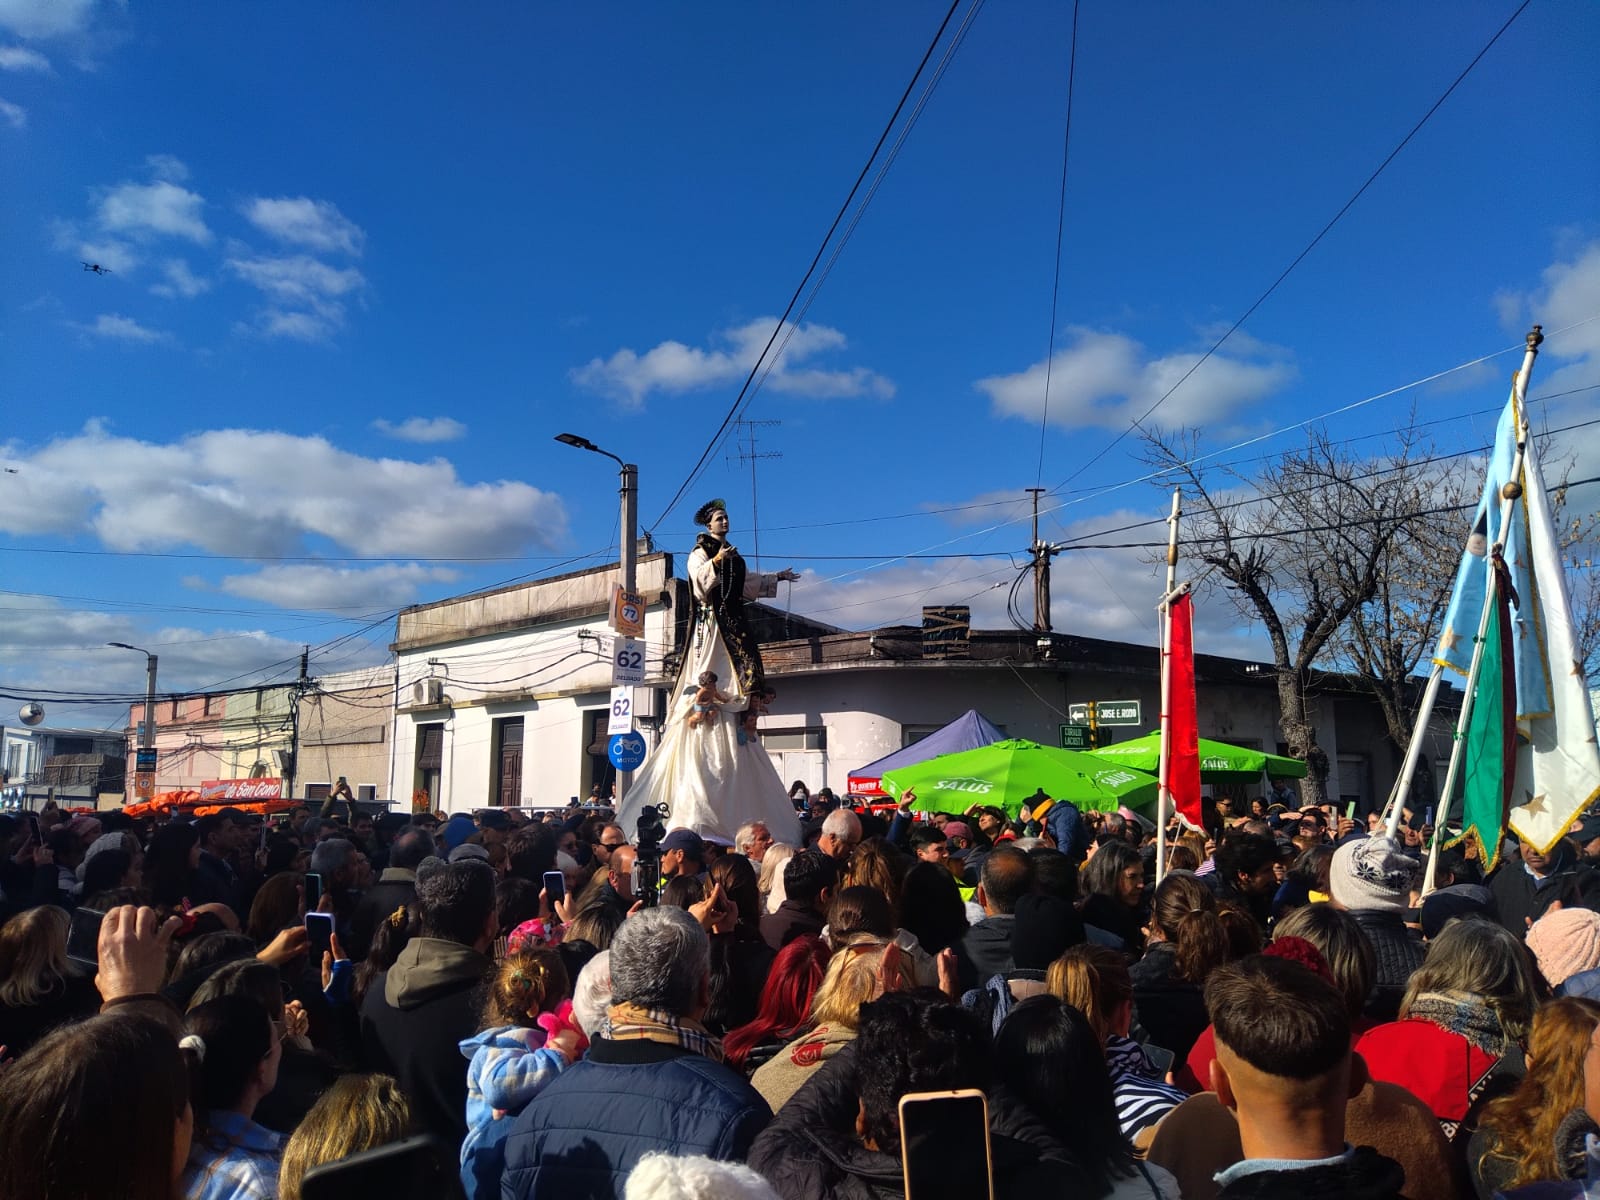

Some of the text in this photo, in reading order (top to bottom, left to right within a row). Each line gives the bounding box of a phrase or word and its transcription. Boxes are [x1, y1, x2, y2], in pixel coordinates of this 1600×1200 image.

[623, 607, 636, 619] 77
[617, 650, 642, 669] 62
[613, 698, 630, 717] 62
[1201, 759, 1229, 769] SALUS
[933, 780, 994, 794] SALUS
[1101, 771, 1137, 788] SALUS
[236, 781, 255, 797] San
